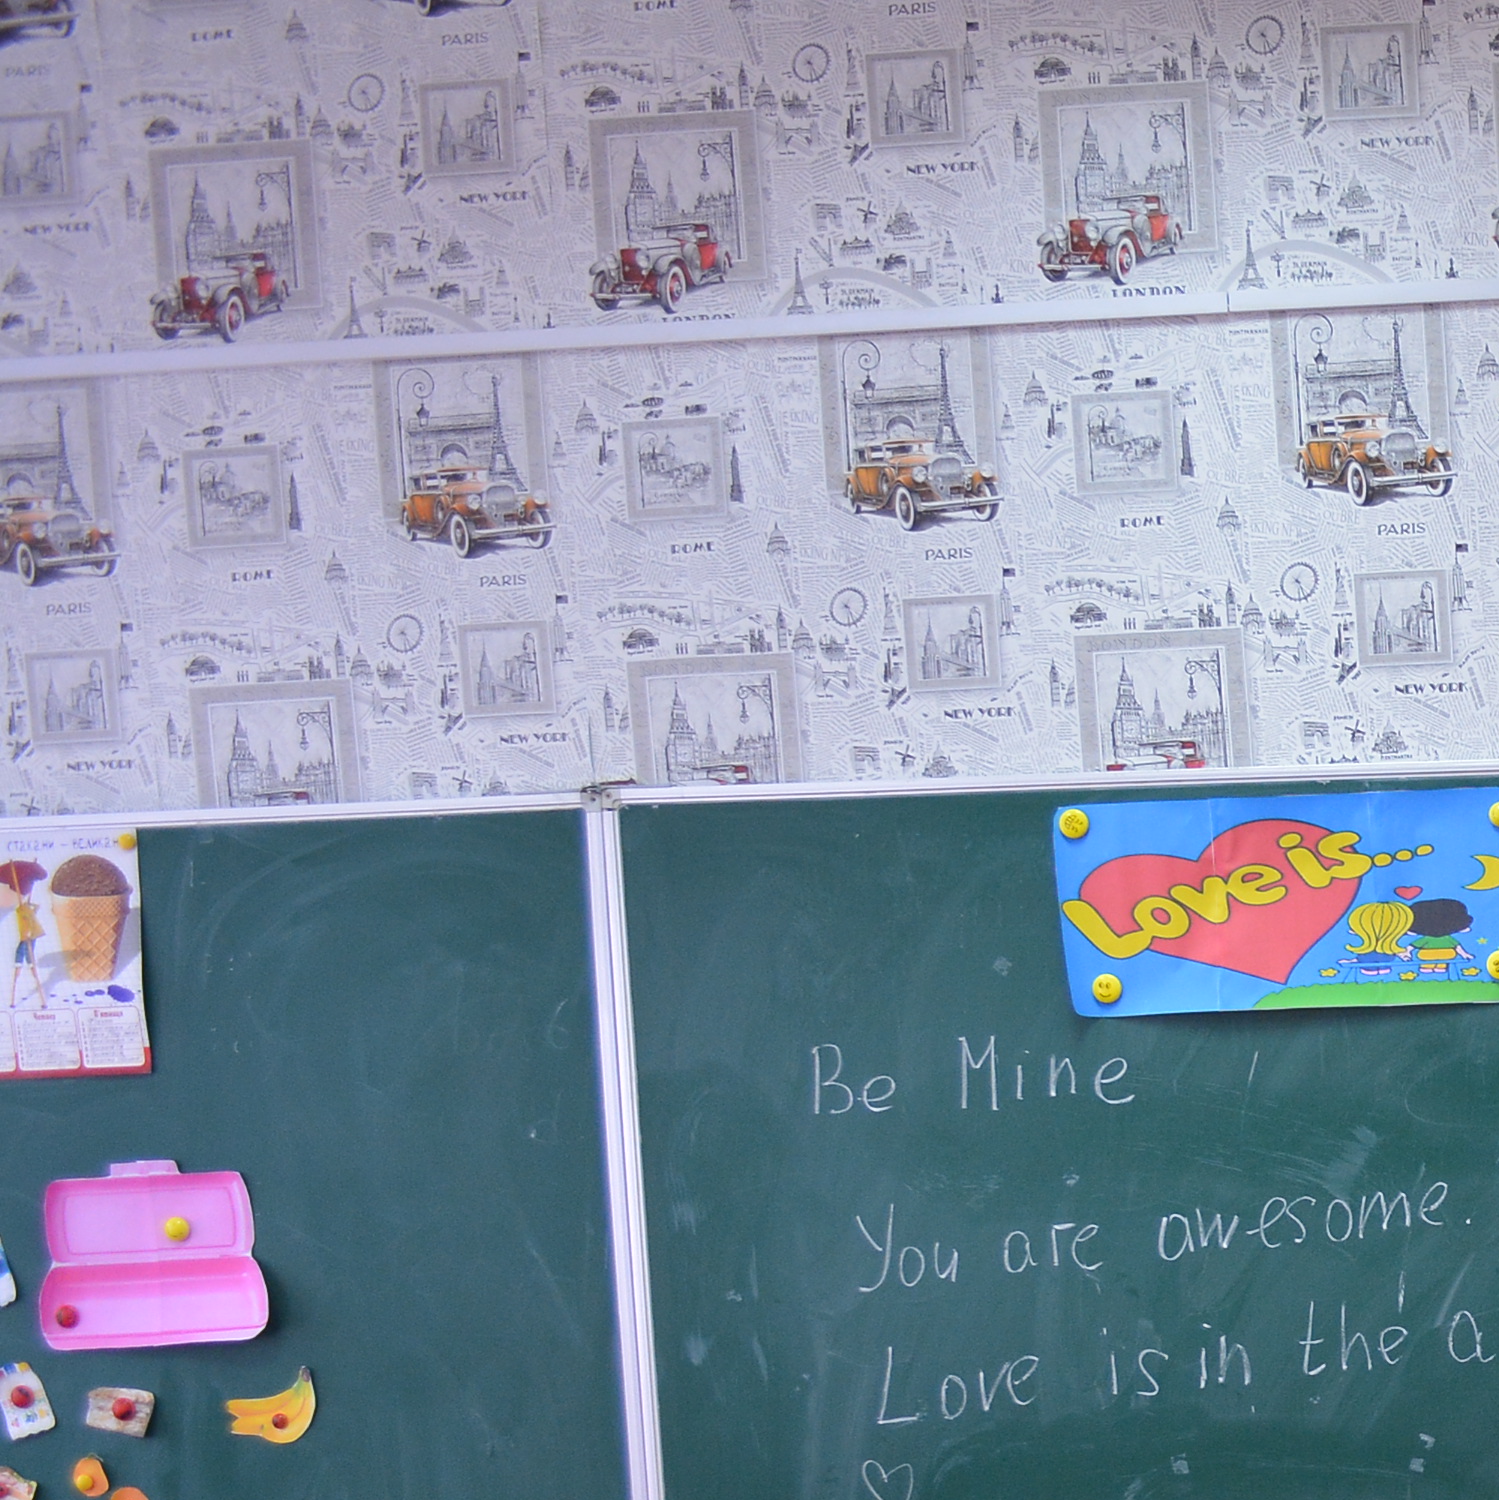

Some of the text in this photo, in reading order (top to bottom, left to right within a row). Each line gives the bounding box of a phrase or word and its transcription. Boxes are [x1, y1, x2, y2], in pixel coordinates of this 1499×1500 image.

[889, 1, 936, 15] PARIS
[442, 32, 490, 46] PARIS
[1360, 136, 1434, 148] NEW YORK
[907, 162, 978, 174] NEW YORK
[1120, 516, 1165, 528] ROME
[1377, 522, 1426, 535] PARIS
[671, 541, 715, 554] ROME
[925, 547, 973, 560] PARIS
[480, 574, 526, 587] PARIS
[46, 602, 91, 615] PARIS
[1395, 682, 1468, 695] NEW YORK
[944, 706, 1016, 719] NEW YORK
[500, 732, 568, 744] NEW YORK
[67, 761, 96, 771] NEW
[1063, 864, 1287, 959] Love
[811, 1034, 1135, 1115] Be Mine
[855, 1181, 1474, 1293] You are awesome.
[877, 1346, 1042, 1425] Love
[1100, 1328, 1170, 1397] is
[1199, 1322, 1252, 1389] in
[1300, 1298, 1407, 1377] the
